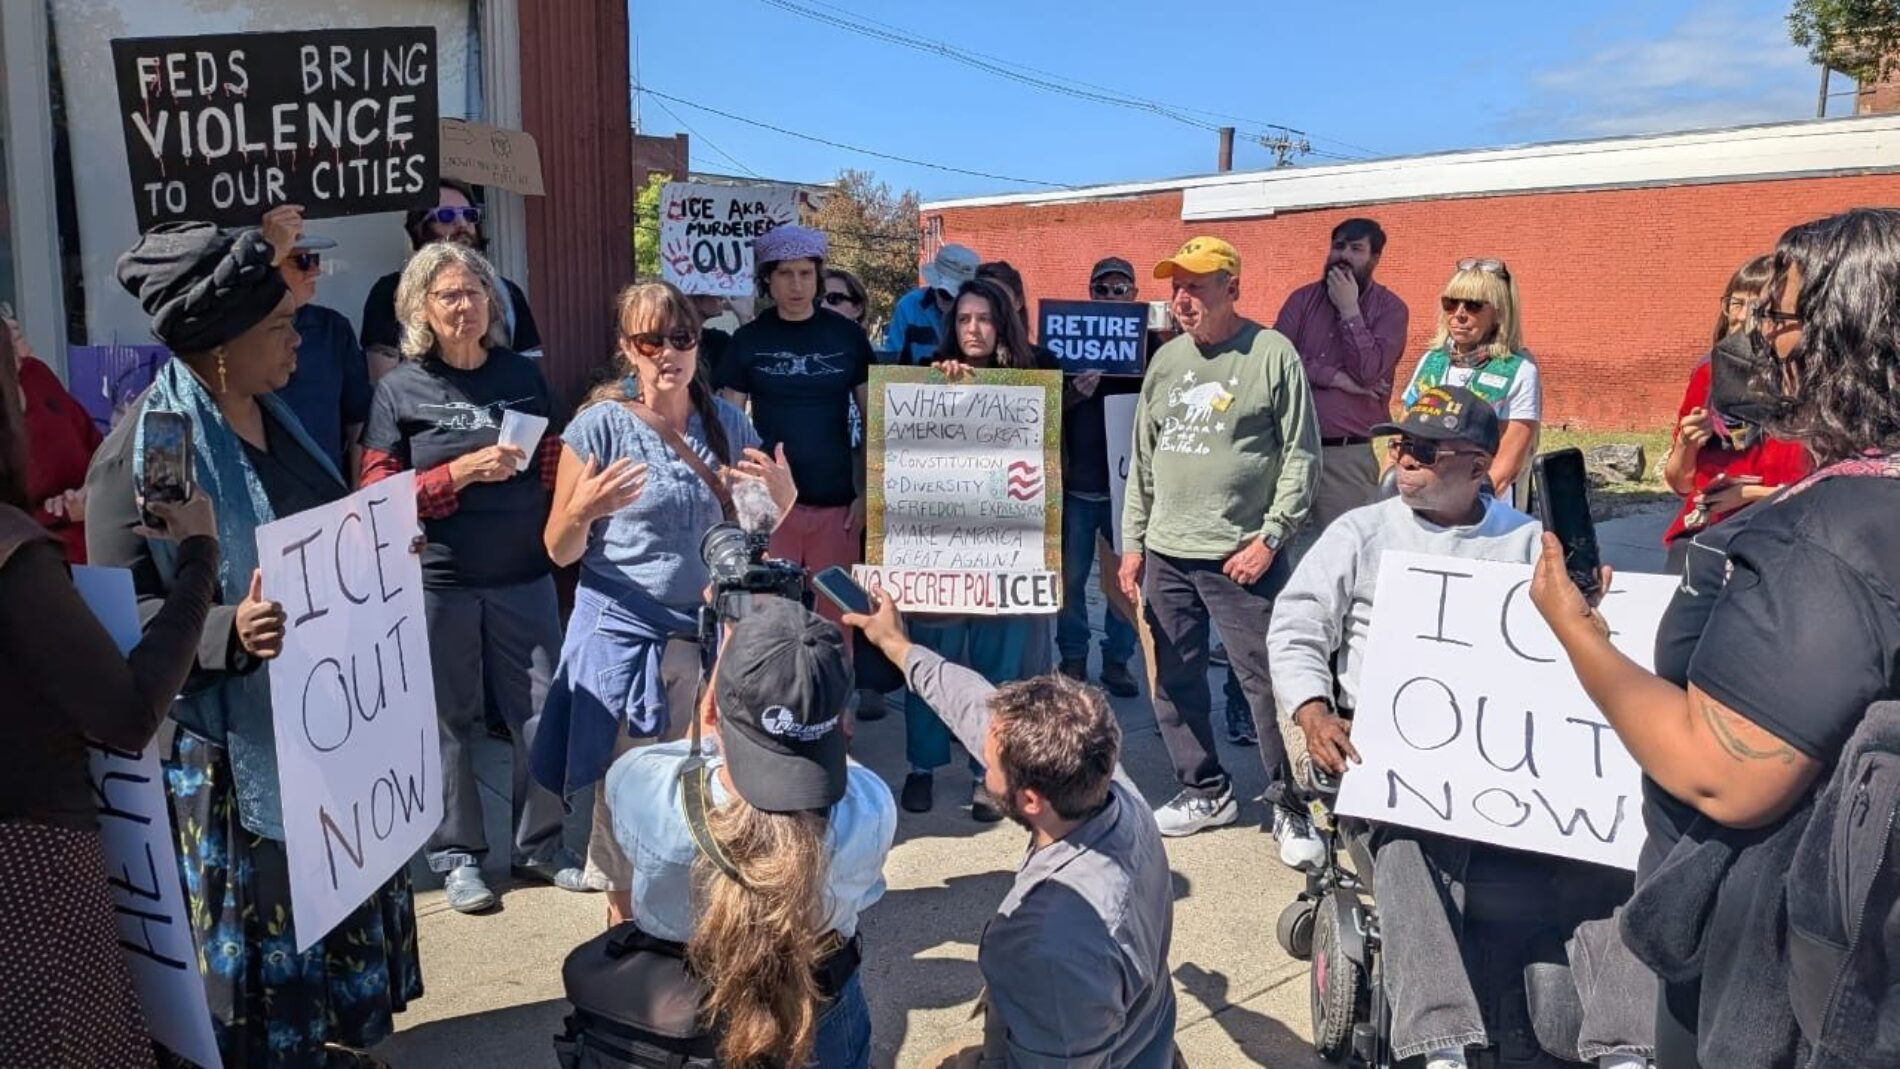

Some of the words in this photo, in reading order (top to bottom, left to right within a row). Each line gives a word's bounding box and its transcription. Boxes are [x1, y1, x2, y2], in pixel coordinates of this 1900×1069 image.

[136, 50, 249, 100] FEDS
[300, 43, 428, 94] BRING
[131, 95, 416, 159] VIOLENCE
[144, 180, 187, 216] TO
[212, 164, 287, 209] OUR
[312, 154, 426, 199] CITIES
[681, 197, 715, 219] ICE
[728, 199, 766, 220] AKA
[1046, 314, 1141, 338] RETIRE
[1047, 338, 1138, 361] SUSAN
[886, 420, 967, 441] AMERICA
[887, 388, 965, 418] WHAT
[966, 391, 1040, 424] MAKES
[900, 475, 985, 493] DIVERSITY
[282, 497, 403, 628] ICE
[888, 523, 940, 547] MAKE
[948, 524, 1023, 549] AMERICA
[889, 571, 961, 607] SECRET
[1407, 567, 1627, 663] IC
[303, 616, 407, 752] OUT
[1391, 676, 1614, 779] OUT
[319, 728, 425, 890] NOW
[1387, 769, 1627, 844] NOW
